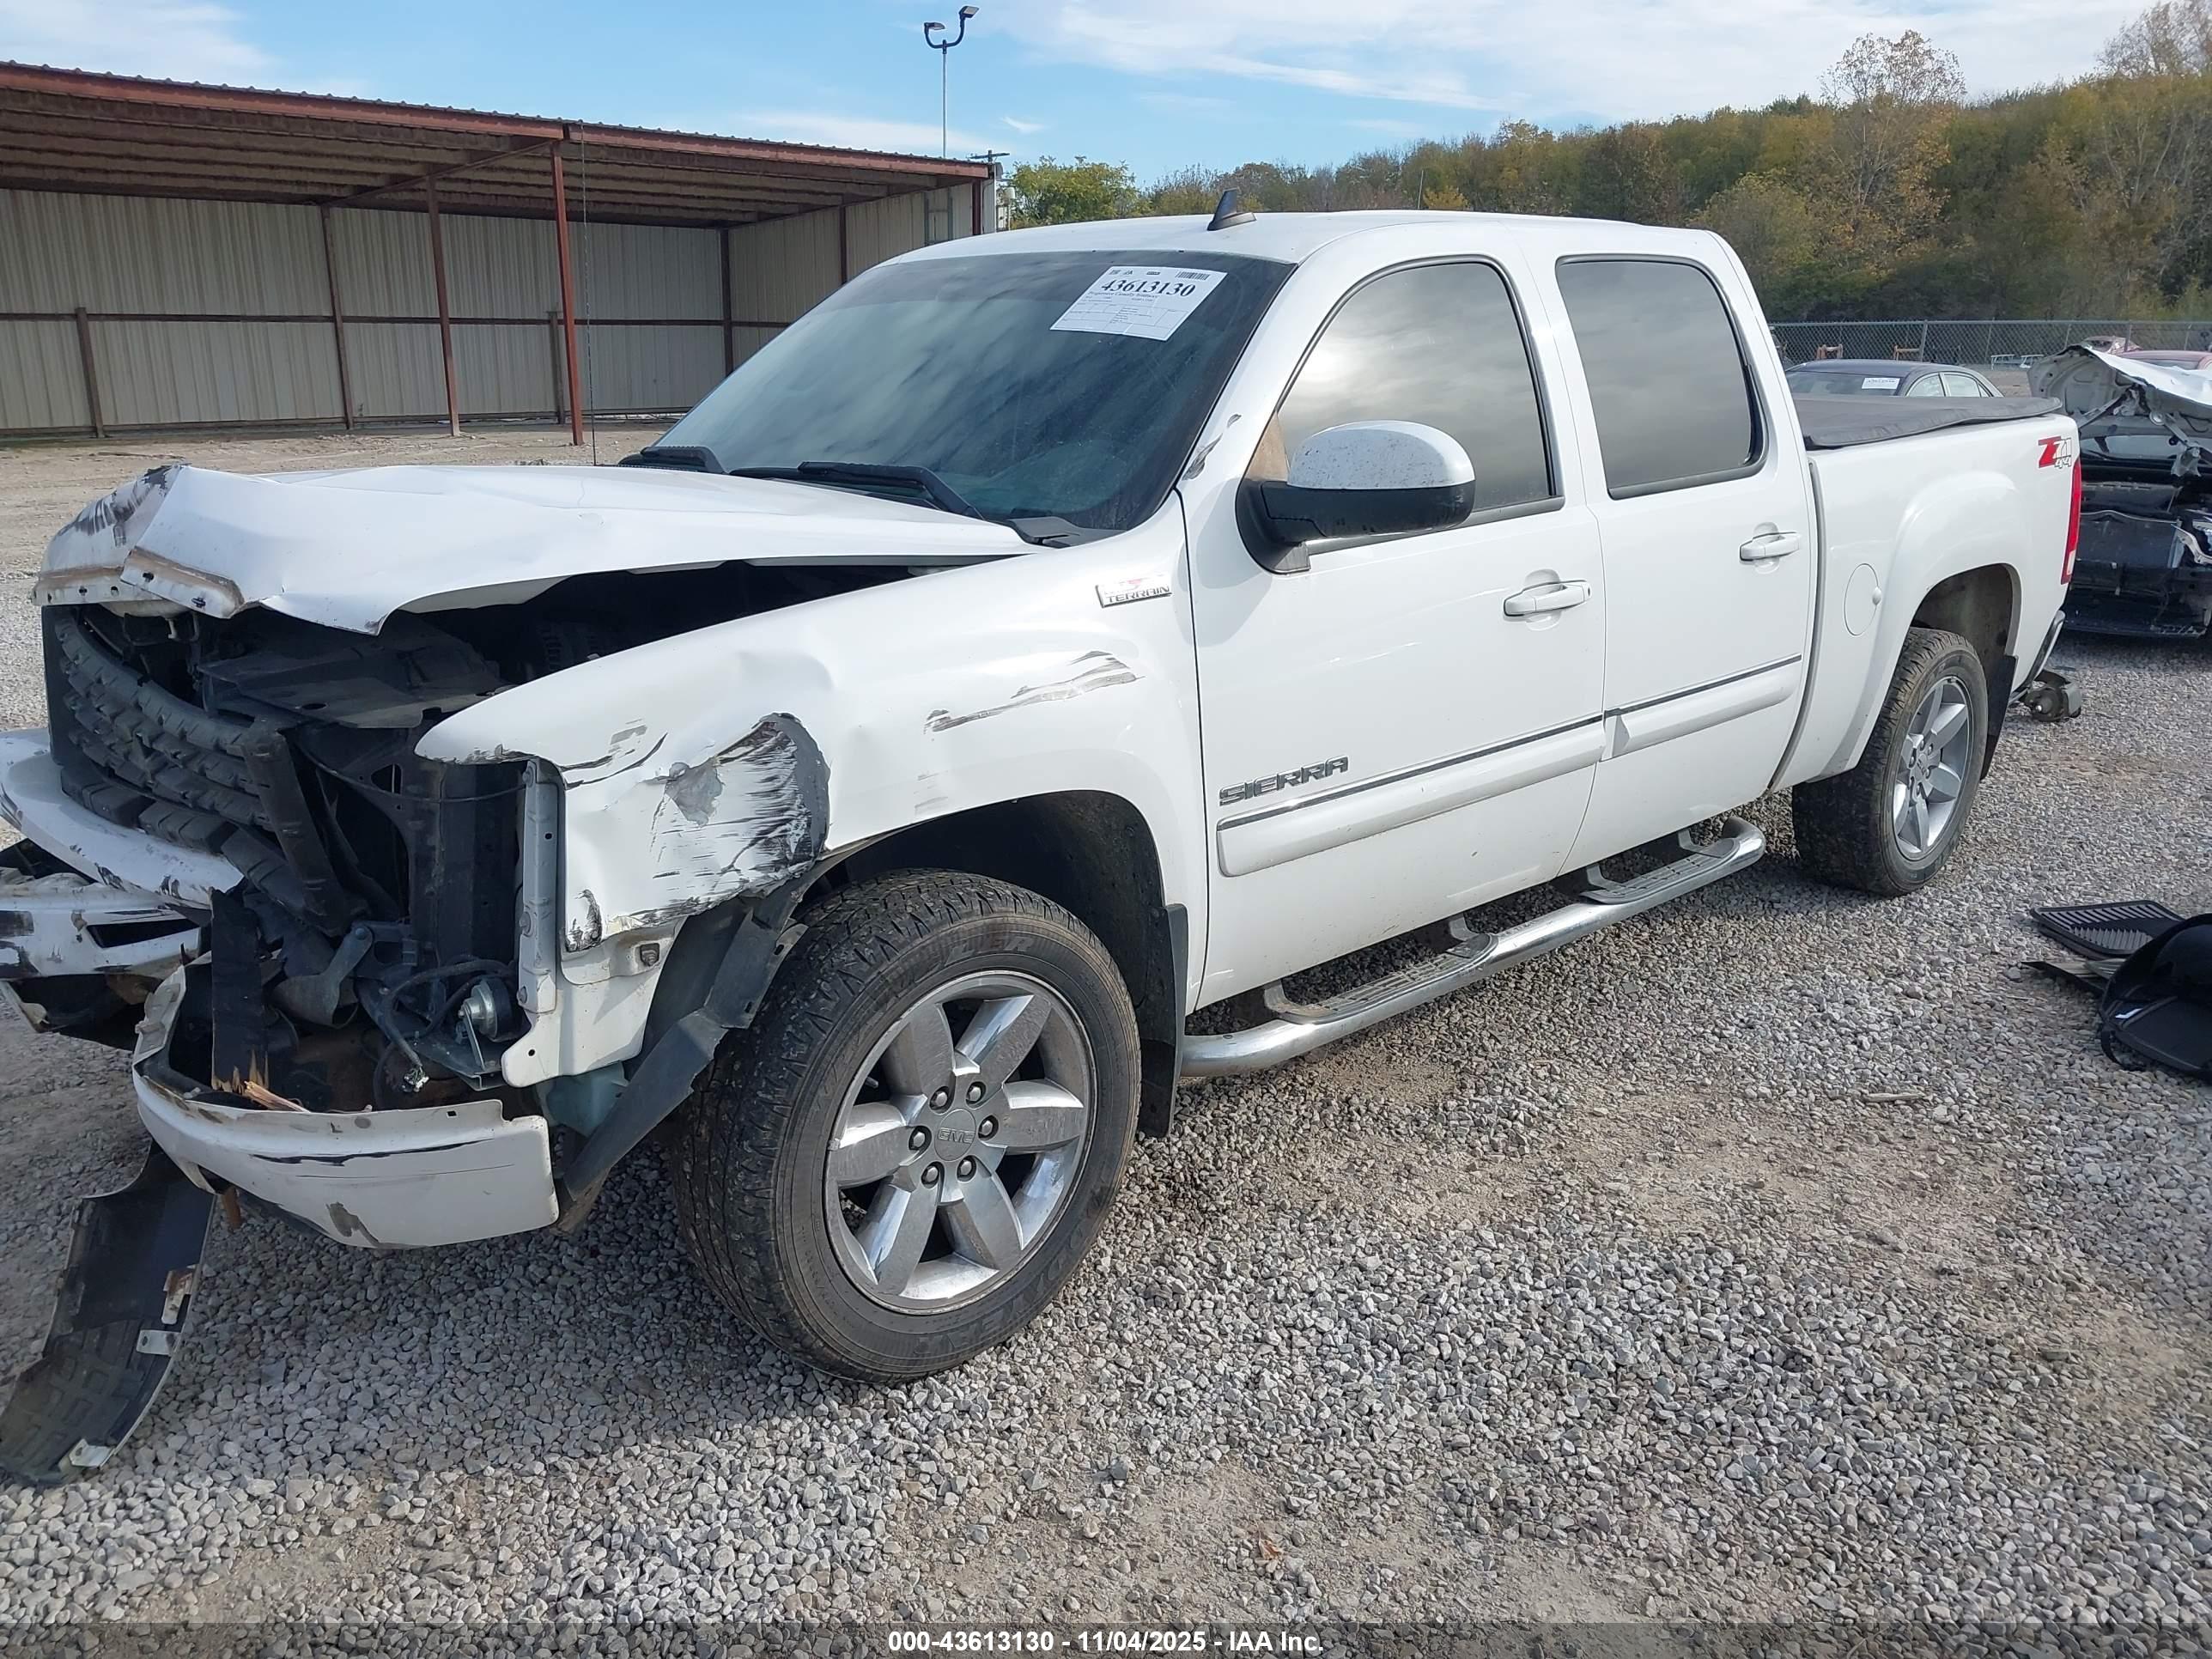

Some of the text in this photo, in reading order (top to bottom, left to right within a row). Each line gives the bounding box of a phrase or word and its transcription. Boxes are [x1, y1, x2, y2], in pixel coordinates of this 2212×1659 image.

[1101, 279, 1196, 297] 43613130
[1106, 586, 1170, 603] TERRAIN
[1219, 756, 1349, 806] SIERRA
[939, 1127, 975, 1144] GMC
